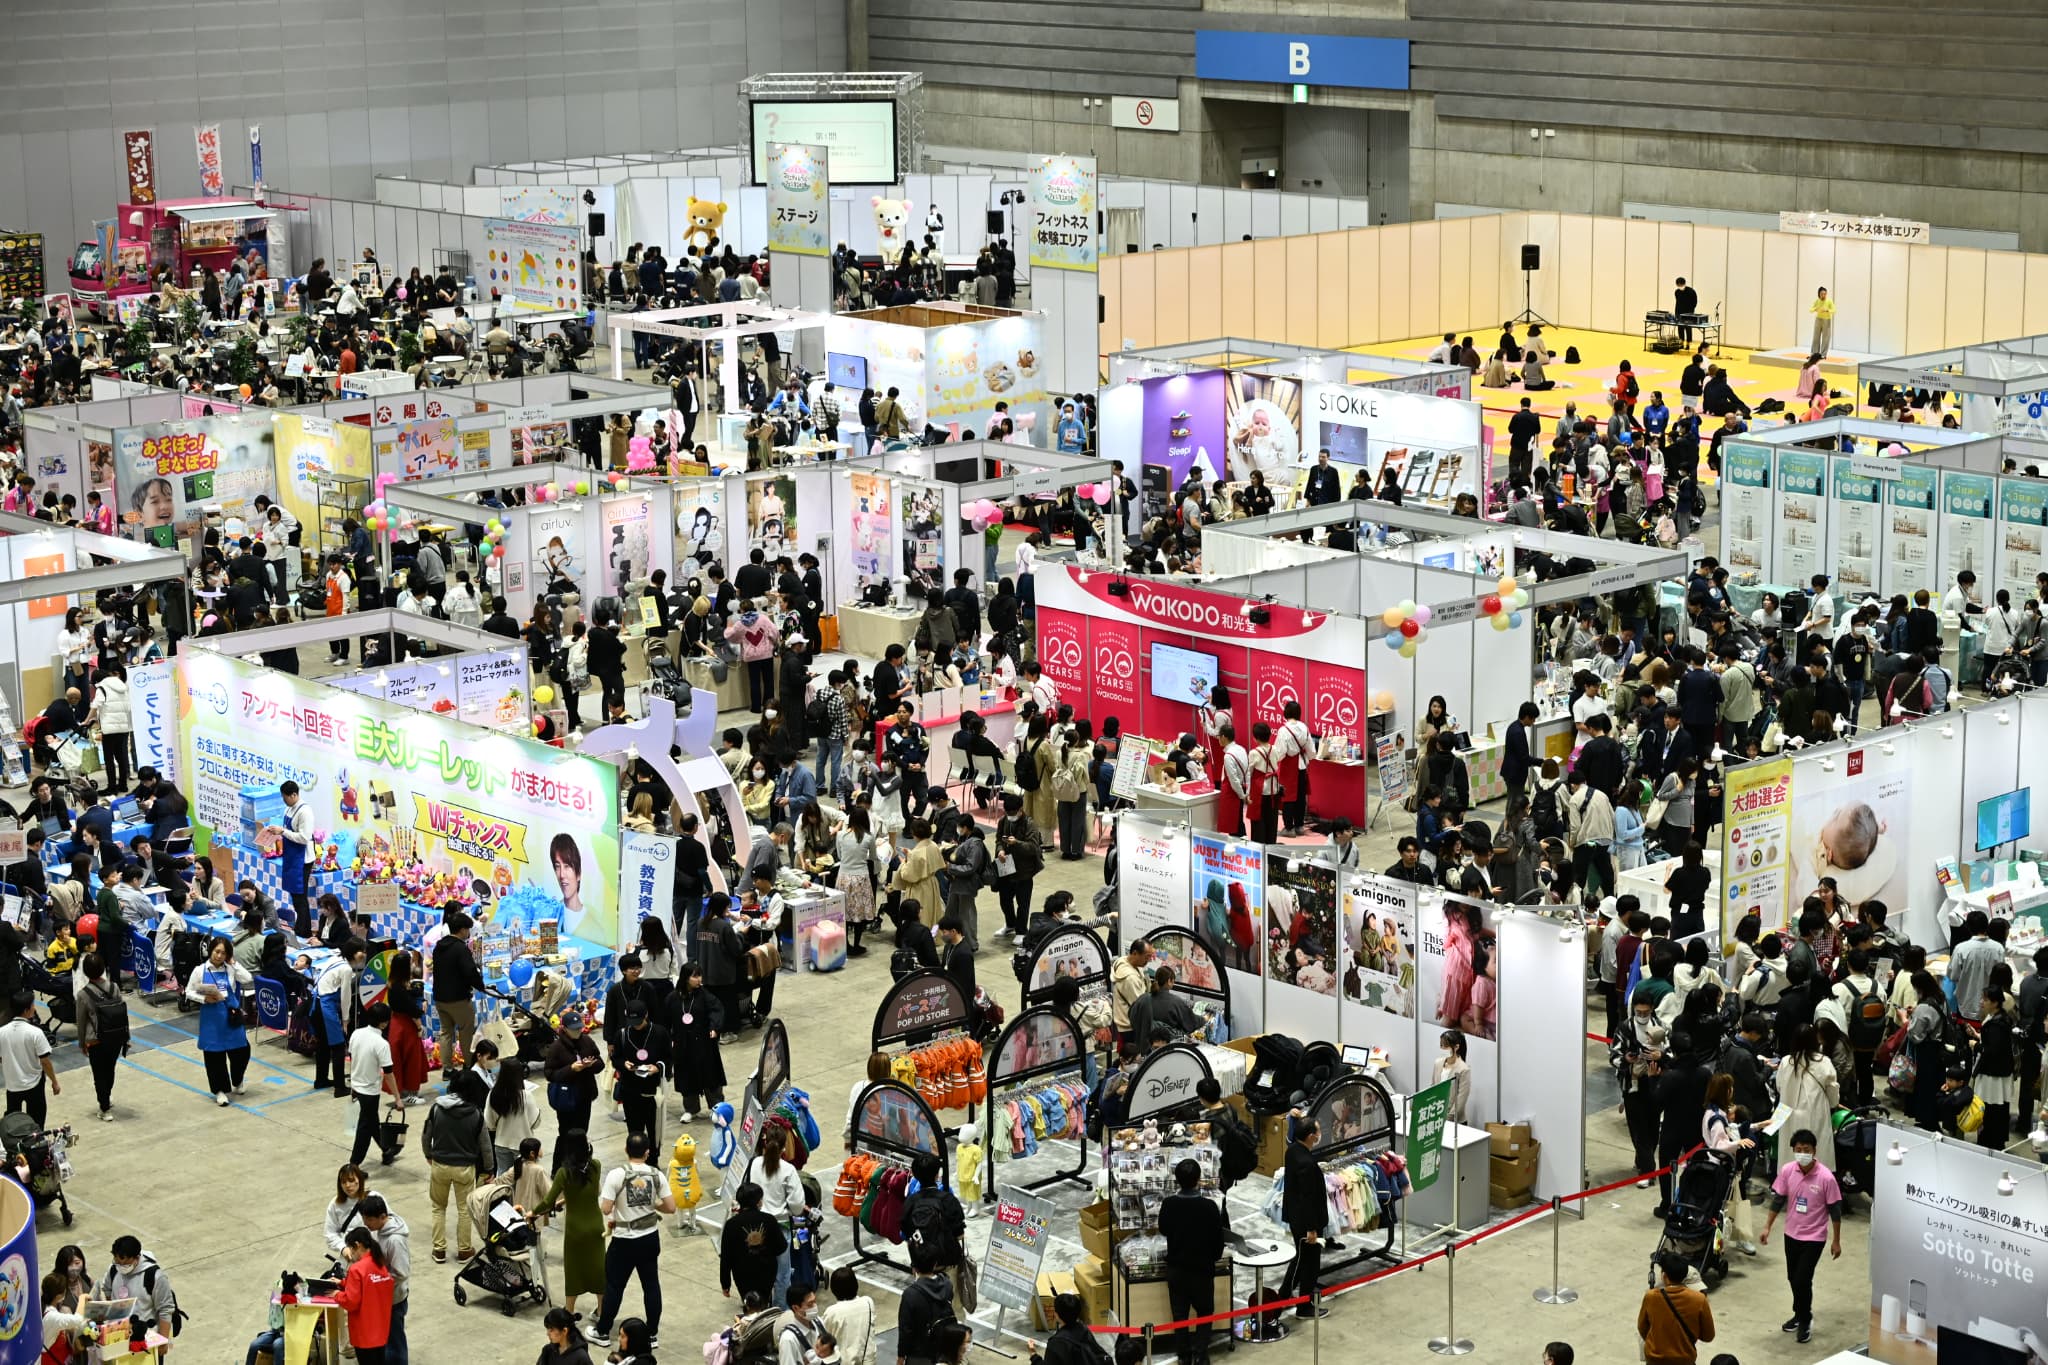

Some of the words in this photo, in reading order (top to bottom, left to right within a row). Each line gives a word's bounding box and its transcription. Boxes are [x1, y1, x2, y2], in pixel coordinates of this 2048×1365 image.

[1289, 42, 1310, 75] B
[777, 207, 818, 223] ステージ
[1037, 212, 1088, 229] フィットネス
[1038, 230, 1088, 247] 体験エリア
[1820, 220, 1921, 239] フィットネス体験エリア
[1320, 393, 1378, 417] STOKKE
[142, 433, 207, 458] あそぼっ!
[156, 450, 218, 476] まなぼっ!
[641, 503, 648, 515] 5
[1221, 614, 1257, 634] 和光堂
[1044, 635, 1082, 668] 120
[1044, 663, 1073, 679] YEARS
[1095, 646, 1133, 678] 120
[389, 676, 417, 688] フルーツ
[462, 669, 522, 685] ストローマグボトル
[1096, 674, 1124, 689] YEARS
[390, 682, 436, 698] ストローップ
[1256, 680, 1299, 711] 120
[1314, 692, 1358, 726] 120
[1315, 721, 1347, 738] YEARS
[242, 691, 349, 742] アンケート回答で
[353, 714, 506, 795] 巨大ルーレット
[511, 767, 593, 812] がまわせる!
[1731, 783, 1788, 815] 大抽選会
[427, 801, 512, 852] Wチャンス
[0, 840, 22, 854] 後尾
[1136, 845, 1172, 862] バースデイ
[1193, 843, 1218, 860] JUST
[1245, 856, 1261, 870] ME
[1205, 858, 1220, 868] NEW
[1221, 861, 1248, 875] FRIENDS
[1352, 886, 1406, 908] &mignon
[1048, 939, 1084, 956] &mignon
[1424, 931, 1444, 946] This
[1424, 942, 1445, 957] That
[897, 993, 950, 1019] バースデイ
[897, 1018, 913, 1029] POP
[914, 1014, 925, 1024] UP
[926, 1008, 950, 1021] STORE
[1418, 1099, 1446, 1123] 友だち
[1417, 1118, 1444, 1141] 募集中
[1000, 1204, 1023, 1218] 10%OFF
[1922, 1231, 1976, 1265] Sotto
[1981, 1248, 2035, 1284] Totte
[1954, 1265, 1999, 1288] ソットトッテ
